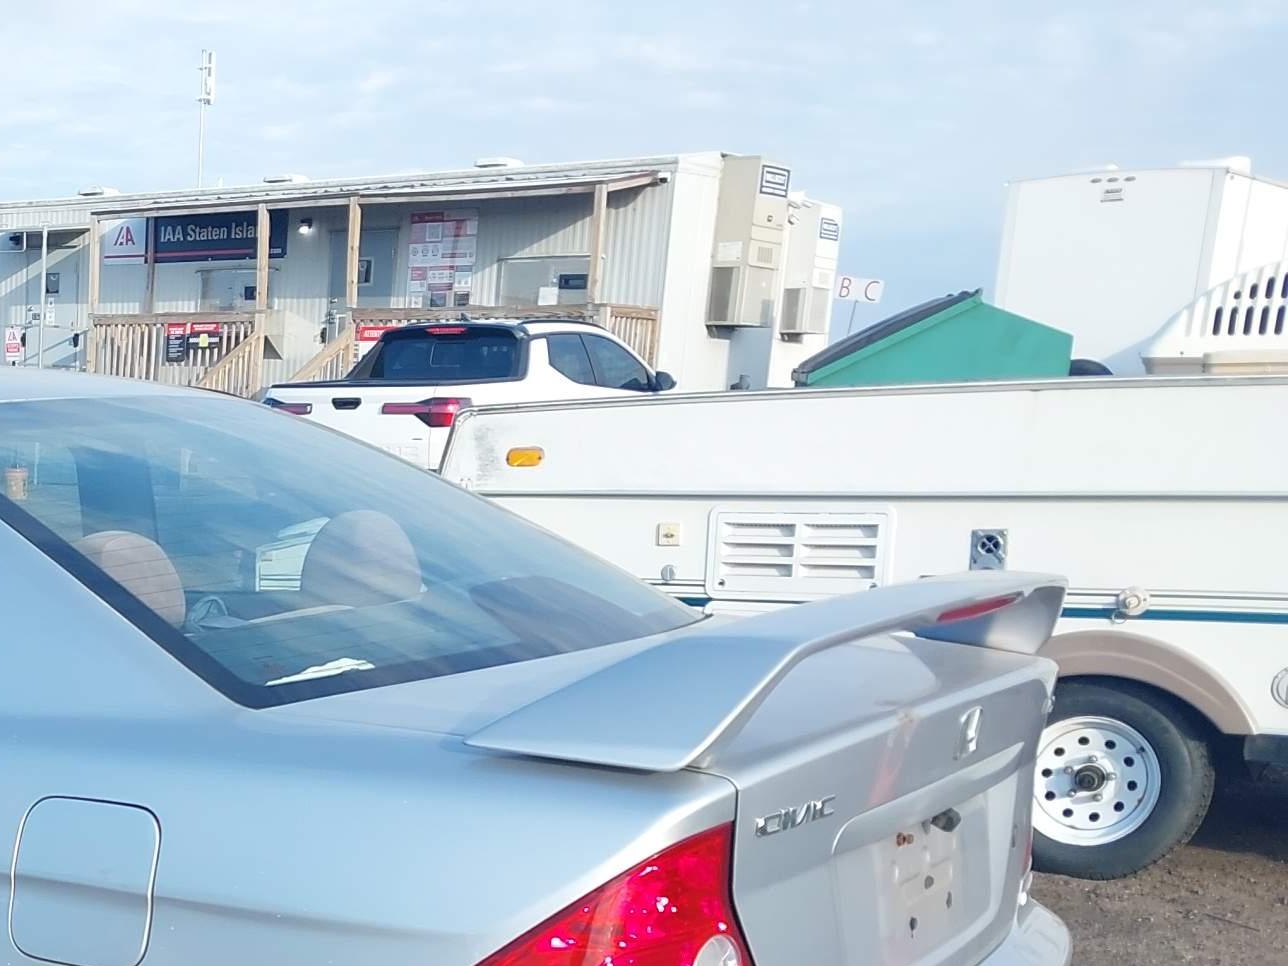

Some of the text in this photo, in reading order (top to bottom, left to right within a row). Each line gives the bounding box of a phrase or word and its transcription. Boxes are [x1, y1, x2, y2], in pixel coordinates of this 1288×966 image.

[160, 225, 184, 242] IAA
[187, 222, 227, 242] Staten
[838, 277, 881, 302] B C
[754, 794, 836, 837] CIVIC
